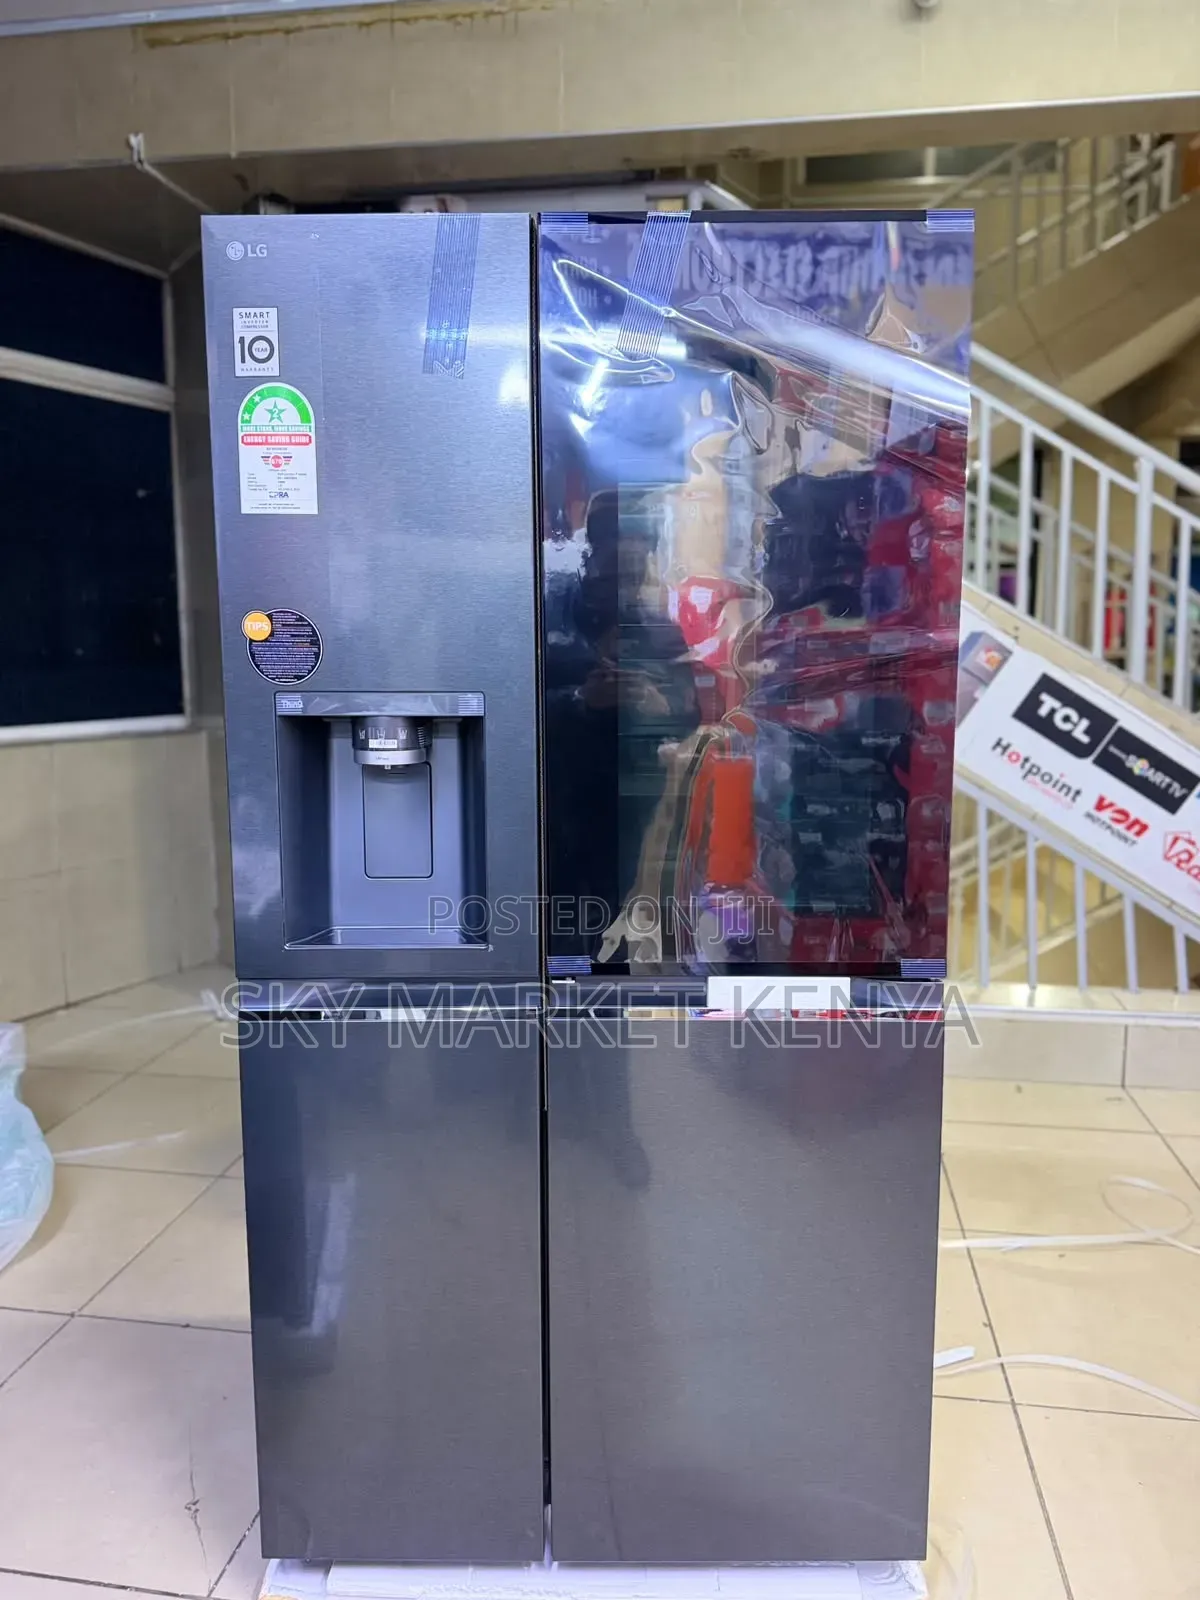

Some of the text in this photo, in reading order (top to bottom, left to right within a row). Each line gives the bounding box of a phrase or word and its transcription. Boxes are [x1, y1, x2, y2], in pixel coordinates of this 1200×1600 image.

[247, 243, 267, 257] LG
[239, 311, 270, 319] SMART
[238, 335, 274, 364] 10
[272, 409, 279, 418] 2
[246, 621, 269, 631] TIPS
[1037, 692, 1091, 745] TCL
[991, 737, 1083, 803] Hotpoint
[1084, 811, 1138, 847] HOTPOINT
